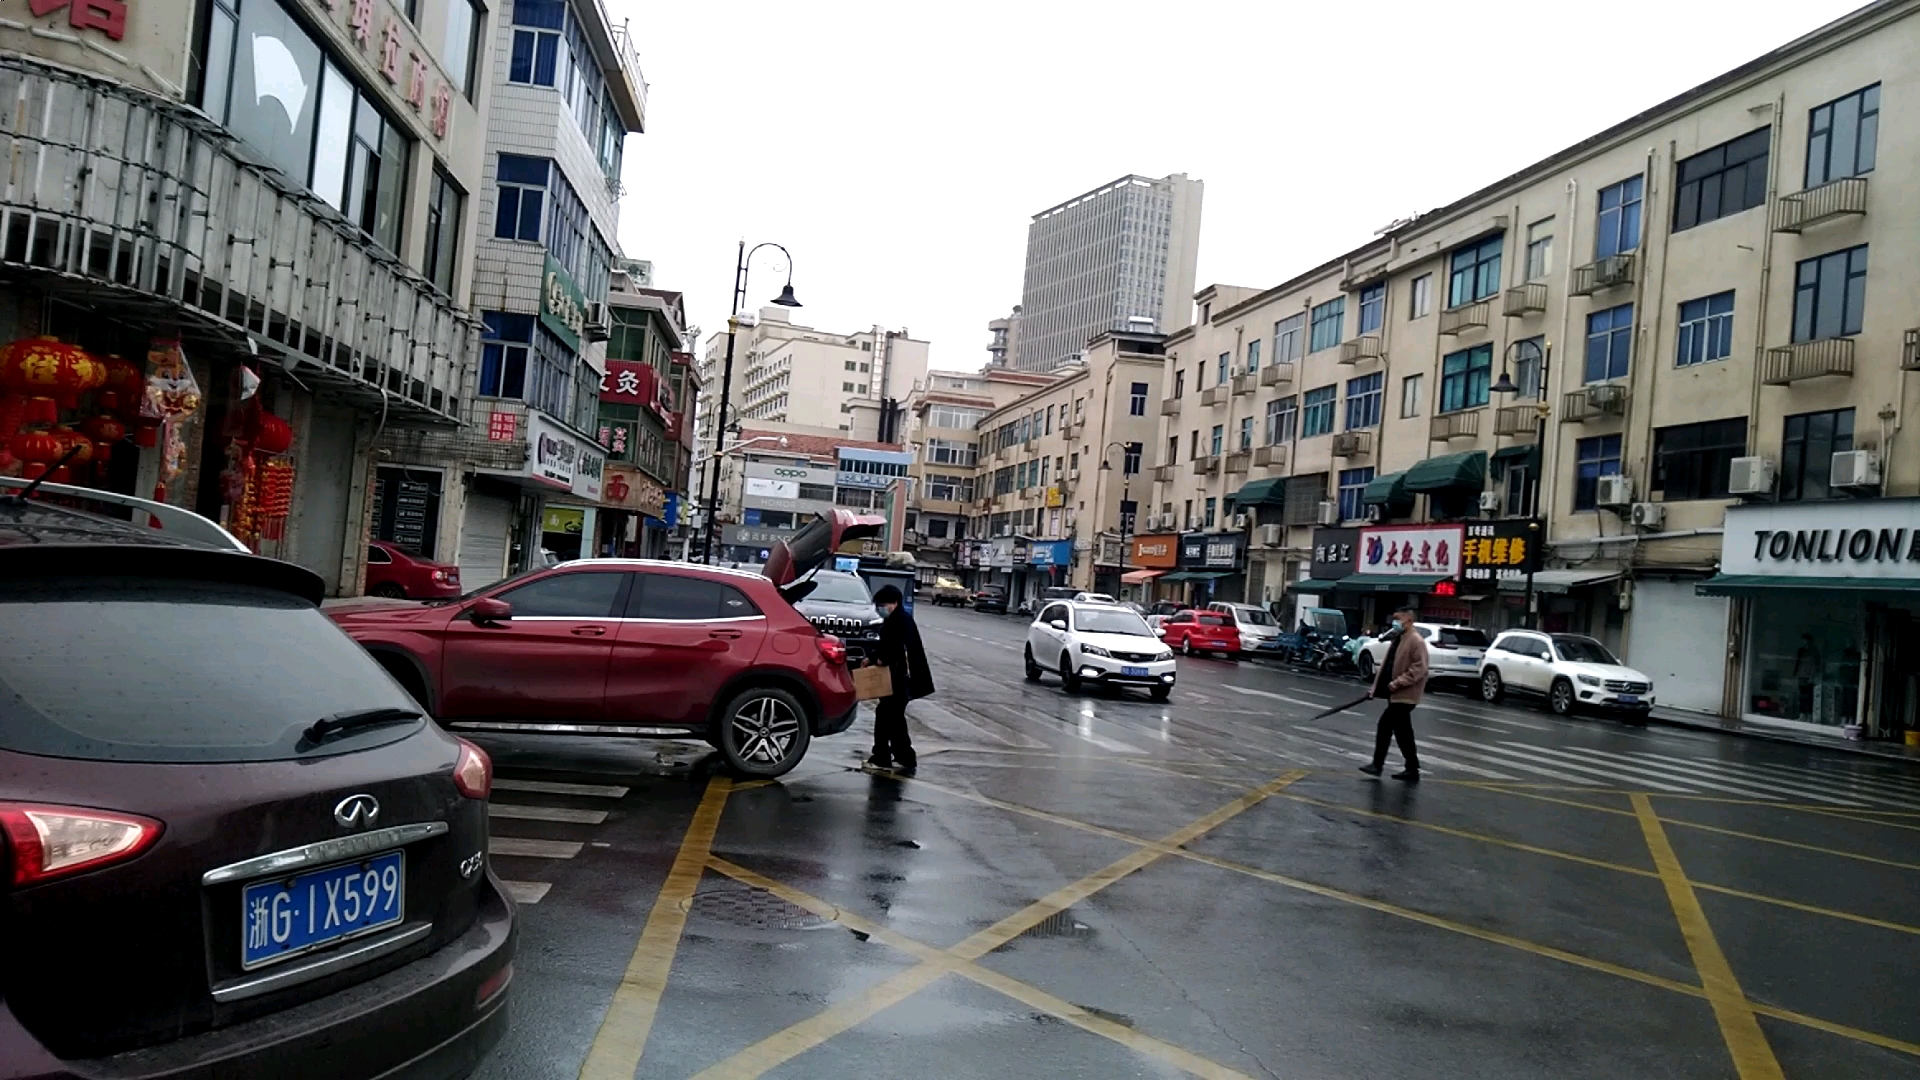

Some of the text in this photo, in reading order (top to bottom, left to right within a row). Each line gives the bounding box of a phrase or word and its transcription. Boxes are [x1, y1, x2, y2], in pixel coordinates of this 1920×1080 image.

[1463, 537, 1526, 565] 手机维修
[1754, 529, 1904, 561] TONLION
